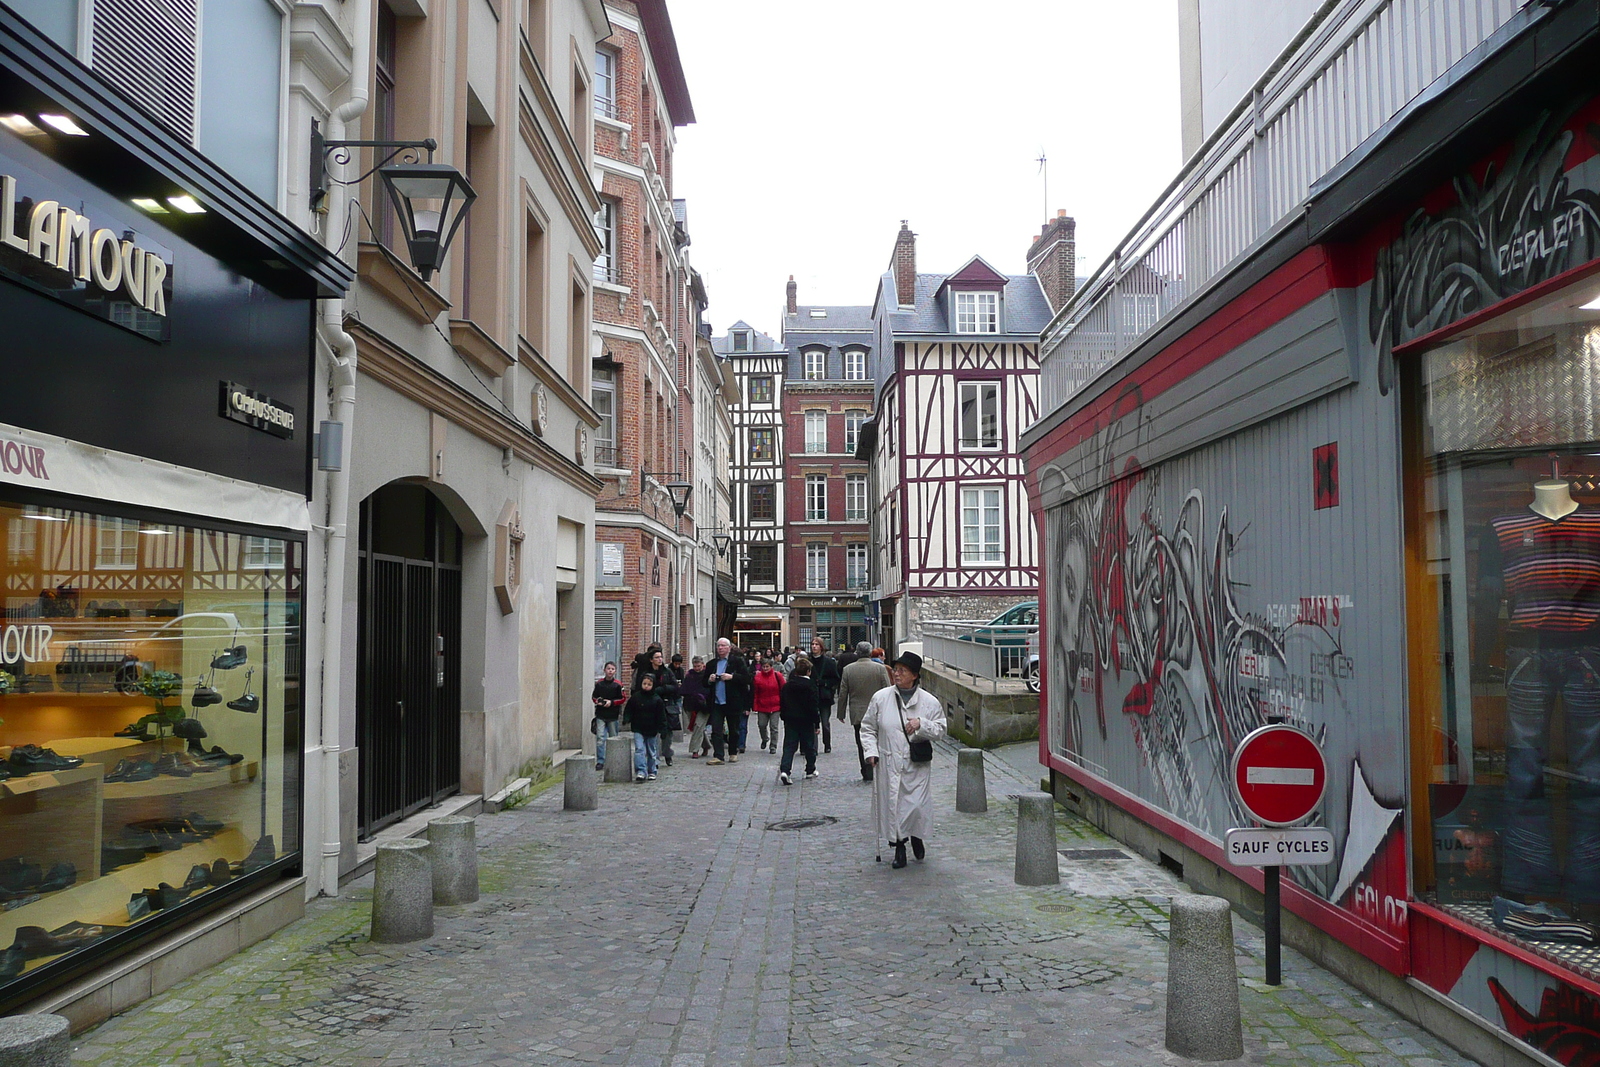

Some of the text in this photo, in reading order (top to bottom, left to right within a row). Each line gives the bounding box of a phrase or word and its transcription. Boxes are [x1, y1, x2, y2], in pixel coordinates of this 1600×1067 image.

[0, 174, 167, 317] LAMOUR
[1499, 204, 1585, 276] DEALER
[231, 390, 294, 431] CHAUSSEUR
[1232, 840, 1330, 855] SAUF CYCLES
